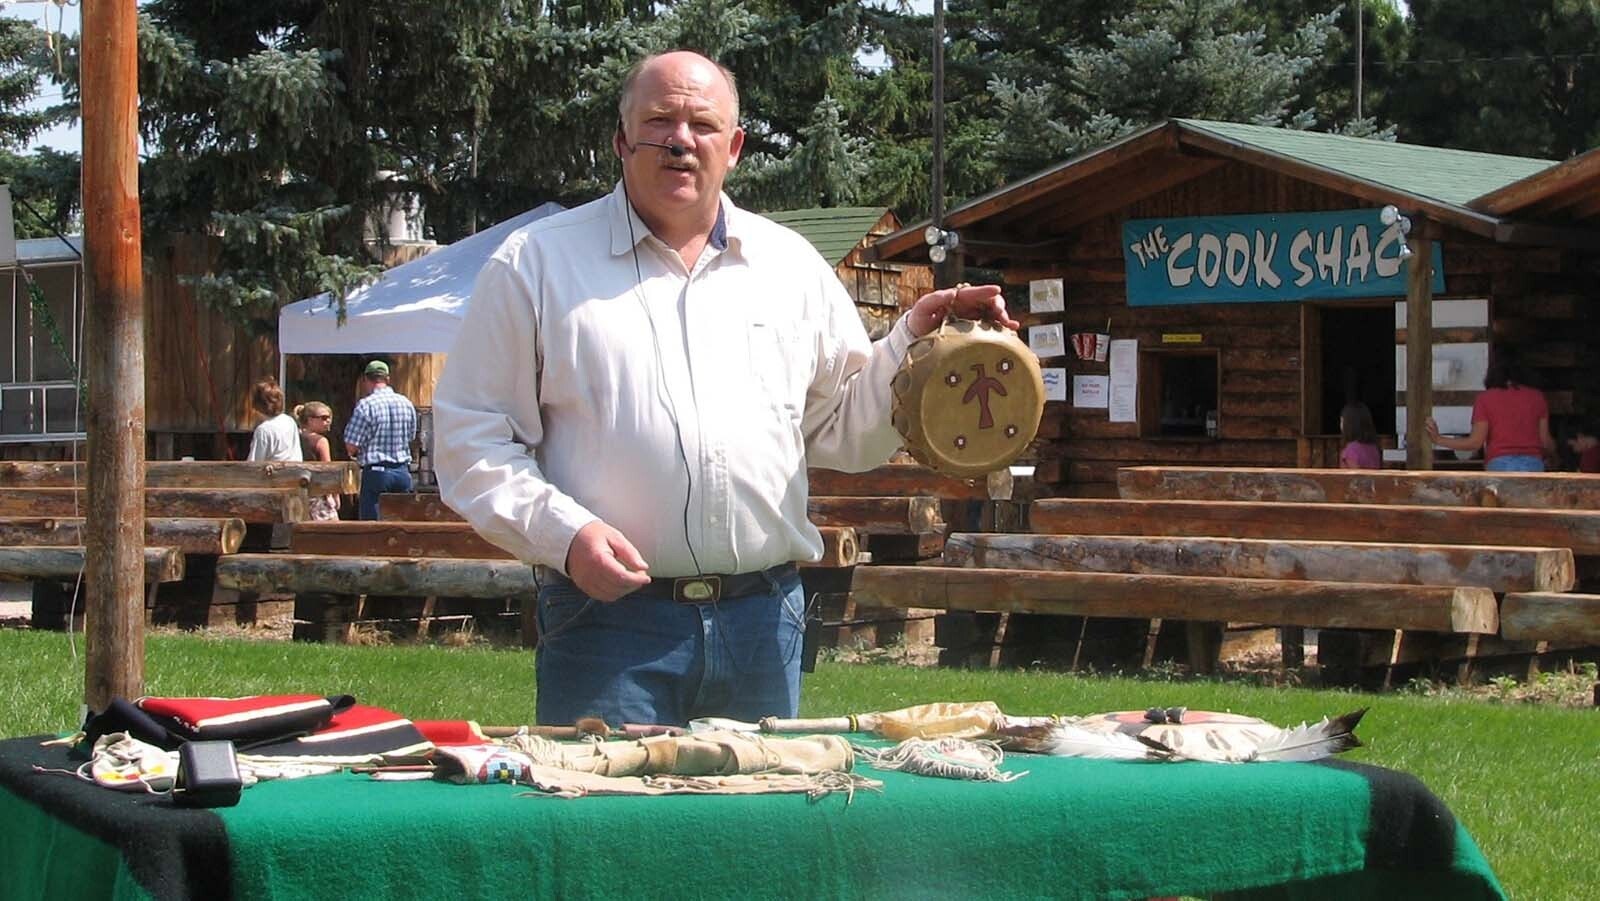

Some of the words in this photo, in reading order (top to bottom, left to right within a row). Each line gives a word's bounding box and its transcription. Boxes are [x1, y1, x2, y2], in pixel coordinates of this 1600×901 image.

[1131, 225, 1169, 268] THE
[1167, 231, 1282, 289] COOK
[1290, 224, 1434, 287] SHAC
